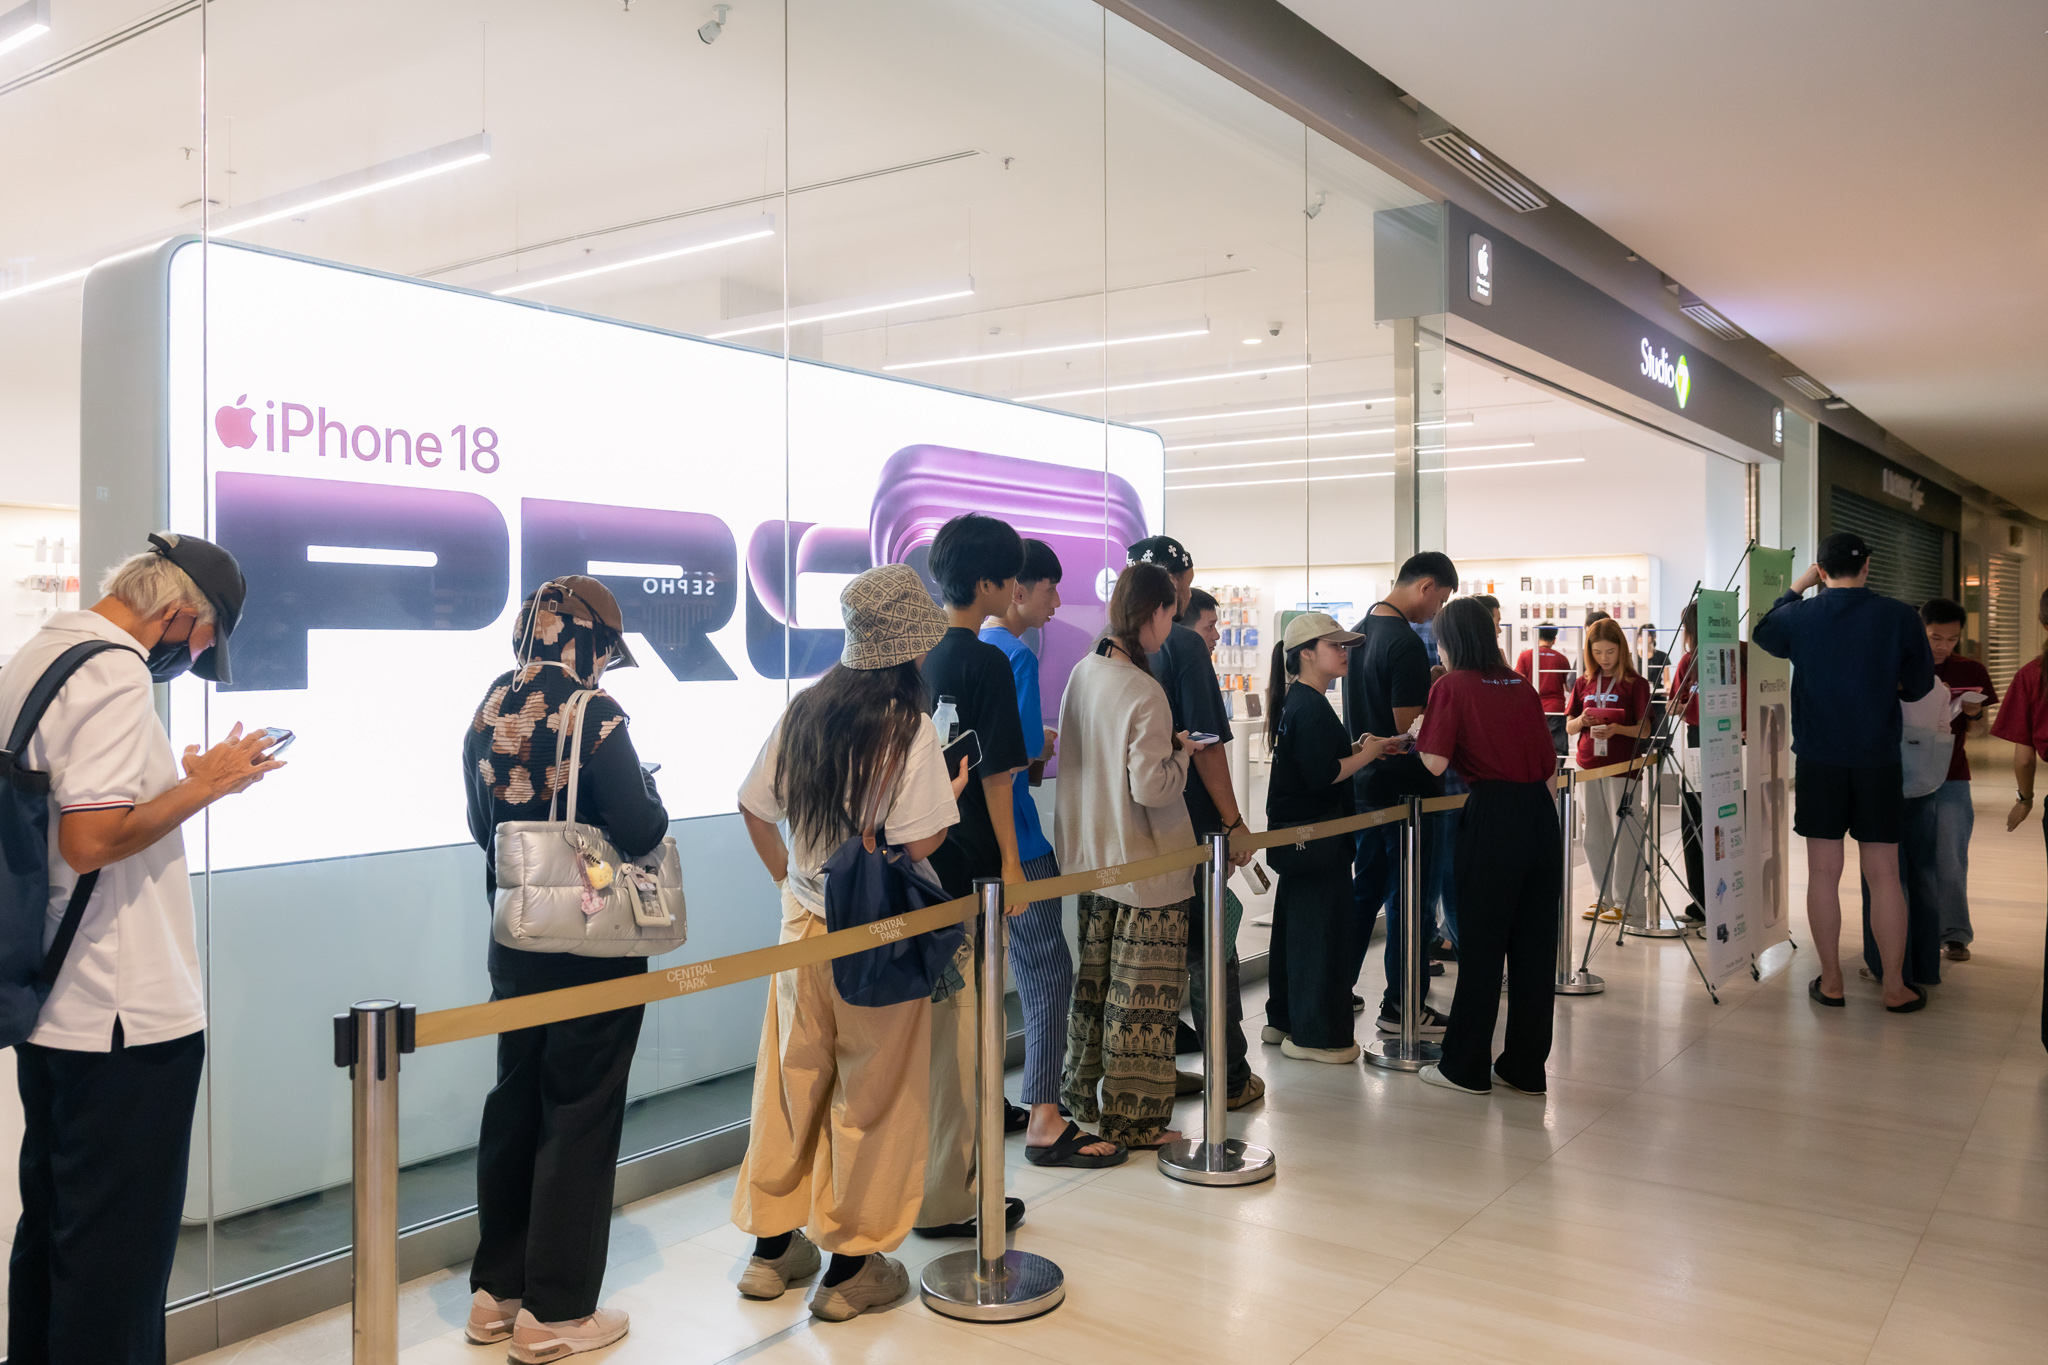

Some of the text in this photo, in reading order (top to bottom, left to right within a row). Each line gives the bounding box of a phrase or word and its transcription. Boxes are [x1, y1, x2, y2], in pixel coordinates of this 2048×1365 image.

[266, 400, 501, 474] iPhone 18
[1096, 867, 1121, 879] CENTRAL
[1102, 876, 1116, 886] PARK
[869, 917, 907, 935] CENTRAL
[880, 928, 903, 942] PARK
[666, 963, 716, 983] CENTRAL
[679, 976, 708, 992] PARK
